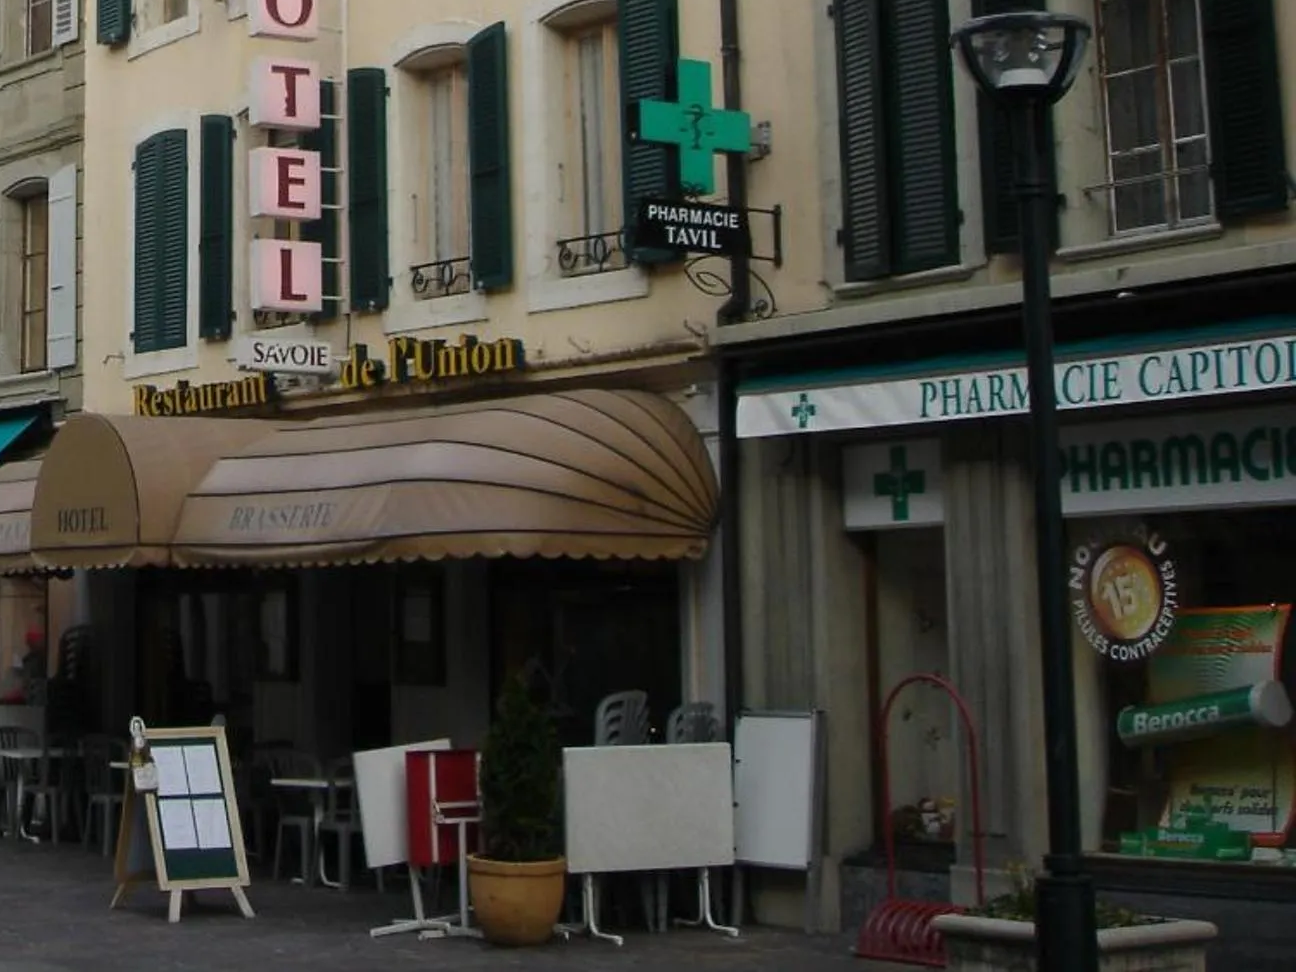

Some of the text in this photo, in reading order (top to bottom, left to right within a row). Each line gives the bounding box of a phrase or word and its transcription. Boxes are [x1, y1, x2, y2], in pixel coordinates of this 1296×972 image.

[648, 204, 740, 229] PHARMACIE
[665, 225, 722, 249] TAVIL
[253, 342, 328, 367] SAVOIE
[133, 333, 517, 417] Restaurant de l'Union
[920, 361, 1122, 418] PHARMCIE
[58, 507, 109, 534] HOTEL
[1072, 559, 1179, 661] PILULES CONTRACEPTIVES
[1133, 704, 1220, 734] Berocca
